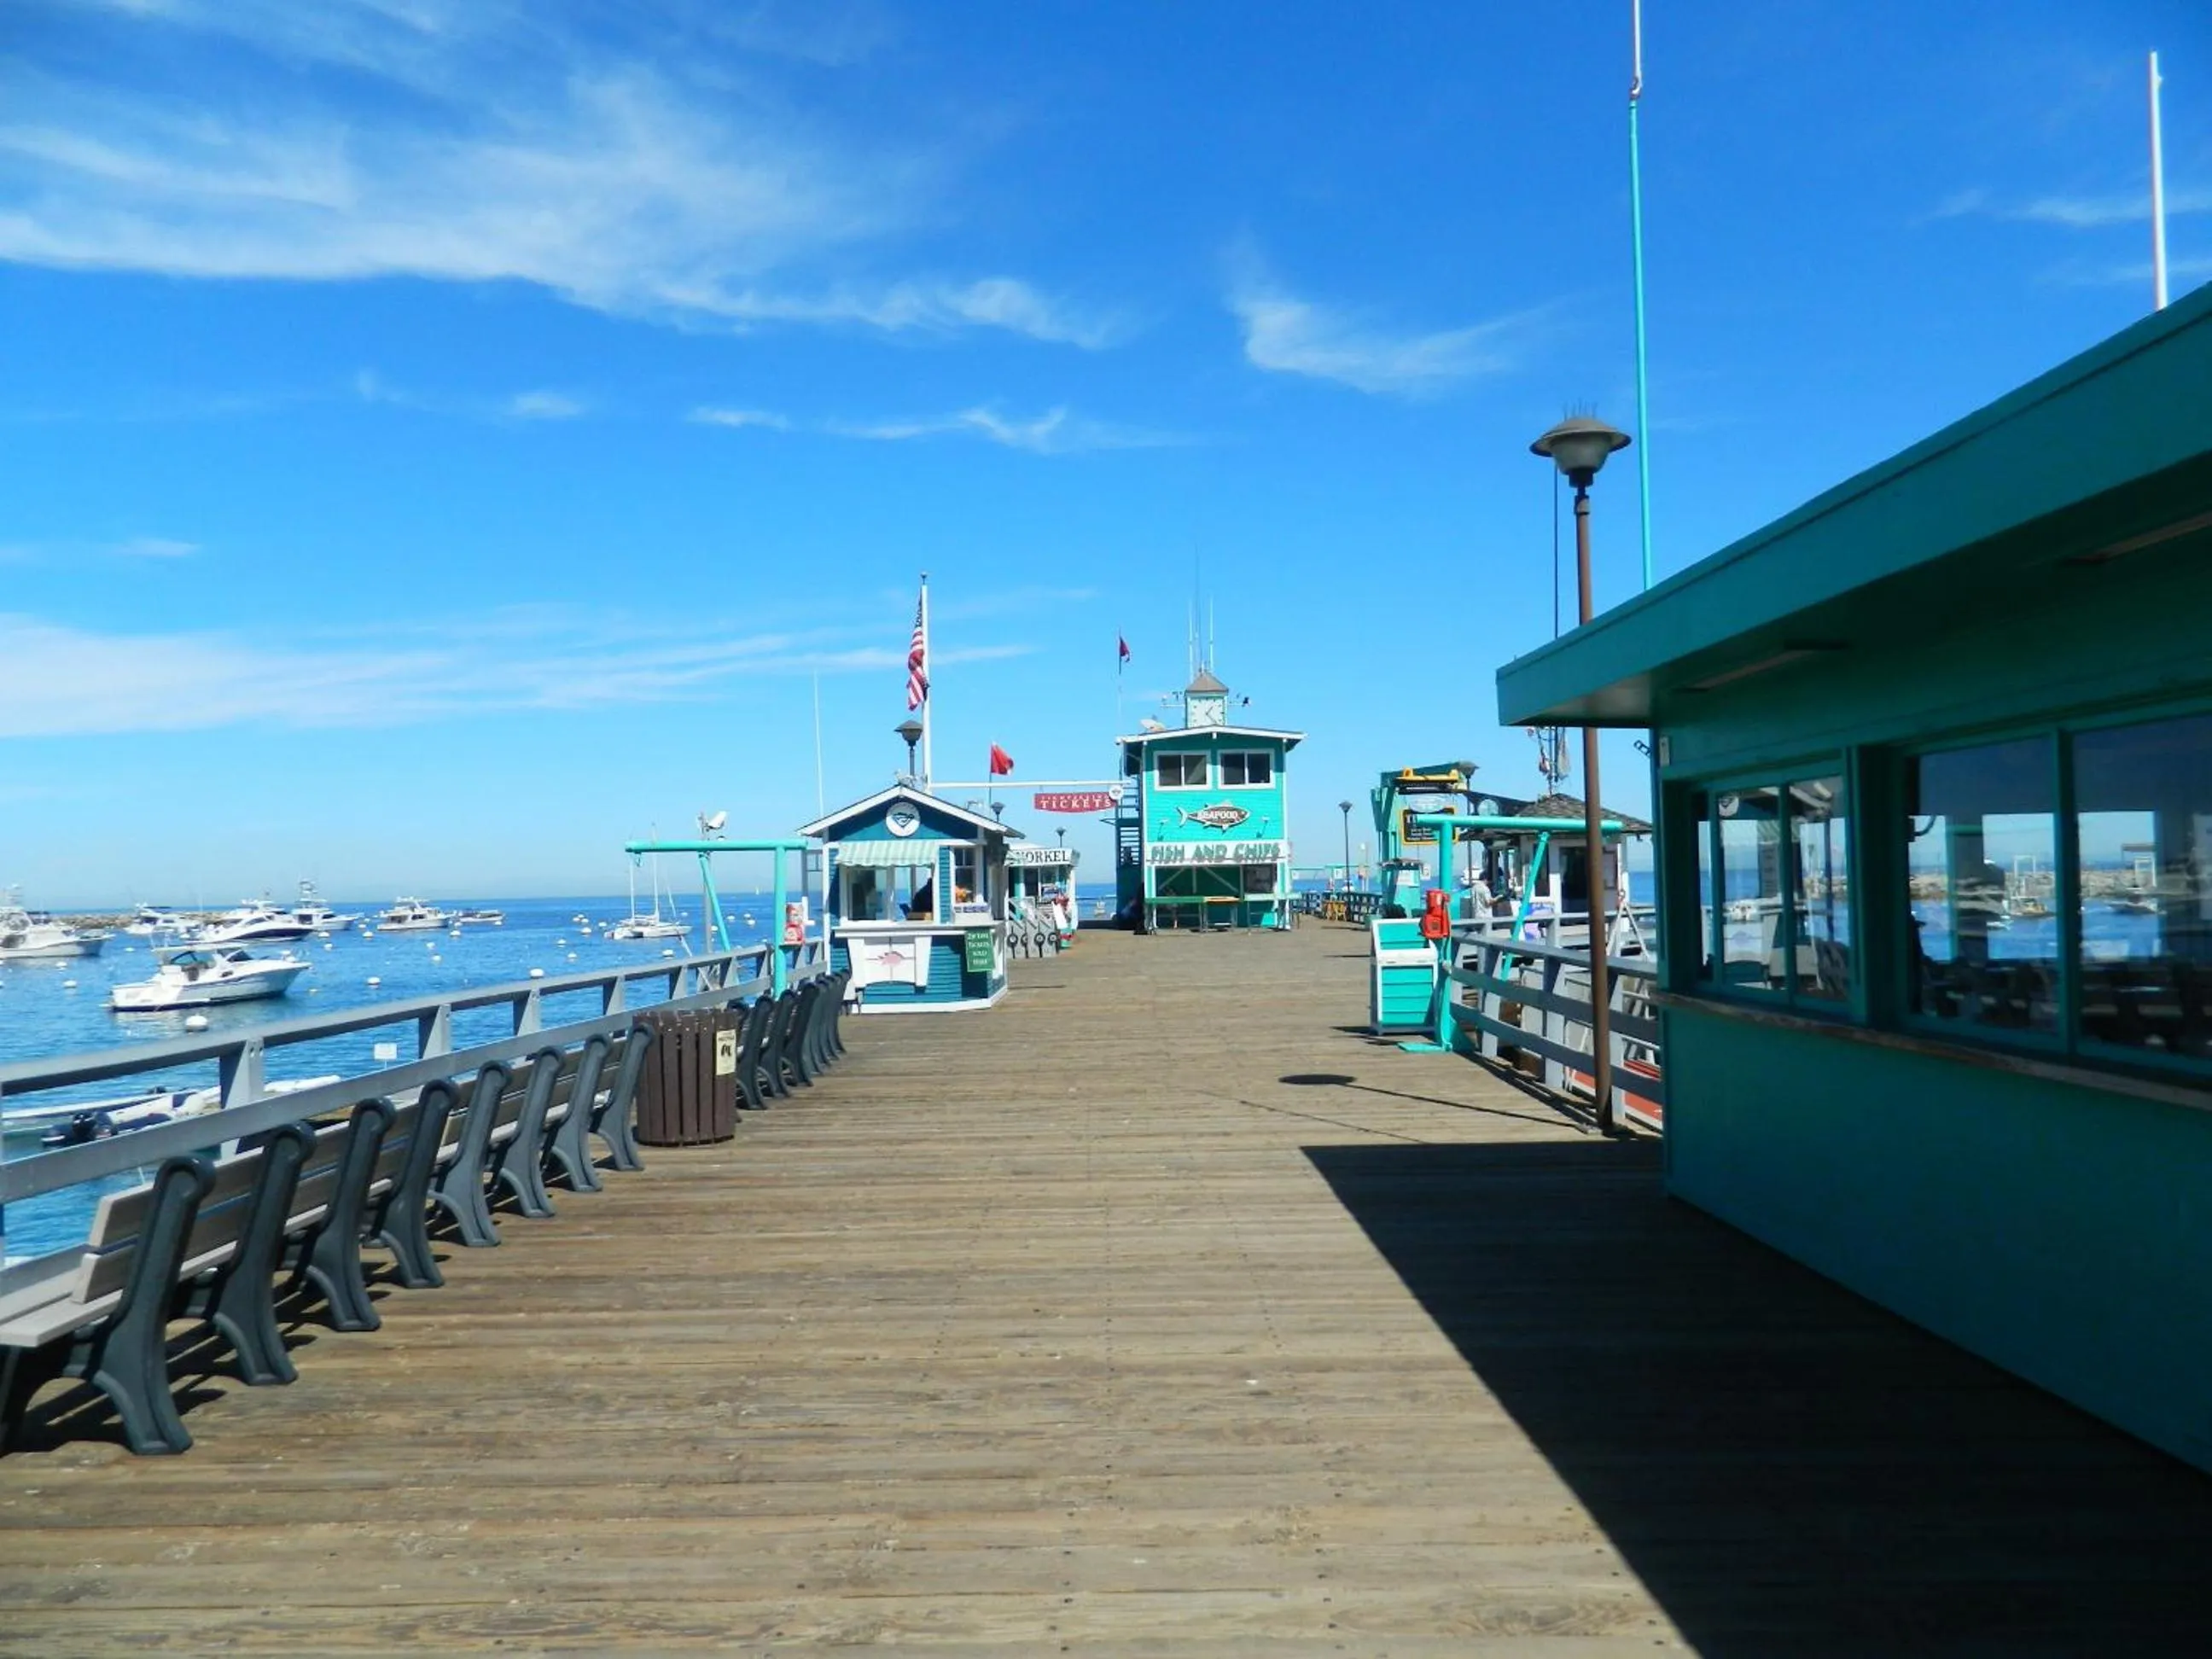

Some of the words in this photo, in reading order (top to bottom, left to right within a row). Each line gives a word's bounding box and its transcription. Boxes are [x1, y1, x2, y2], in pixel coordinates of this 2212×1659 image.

[1040, 799, 1112, 809] TICKETS
[1151, 845, 1185, 863] FISH
[1192, 844, 1227, 862] AND
[1233, 842, 1280, 861] CHIPS
